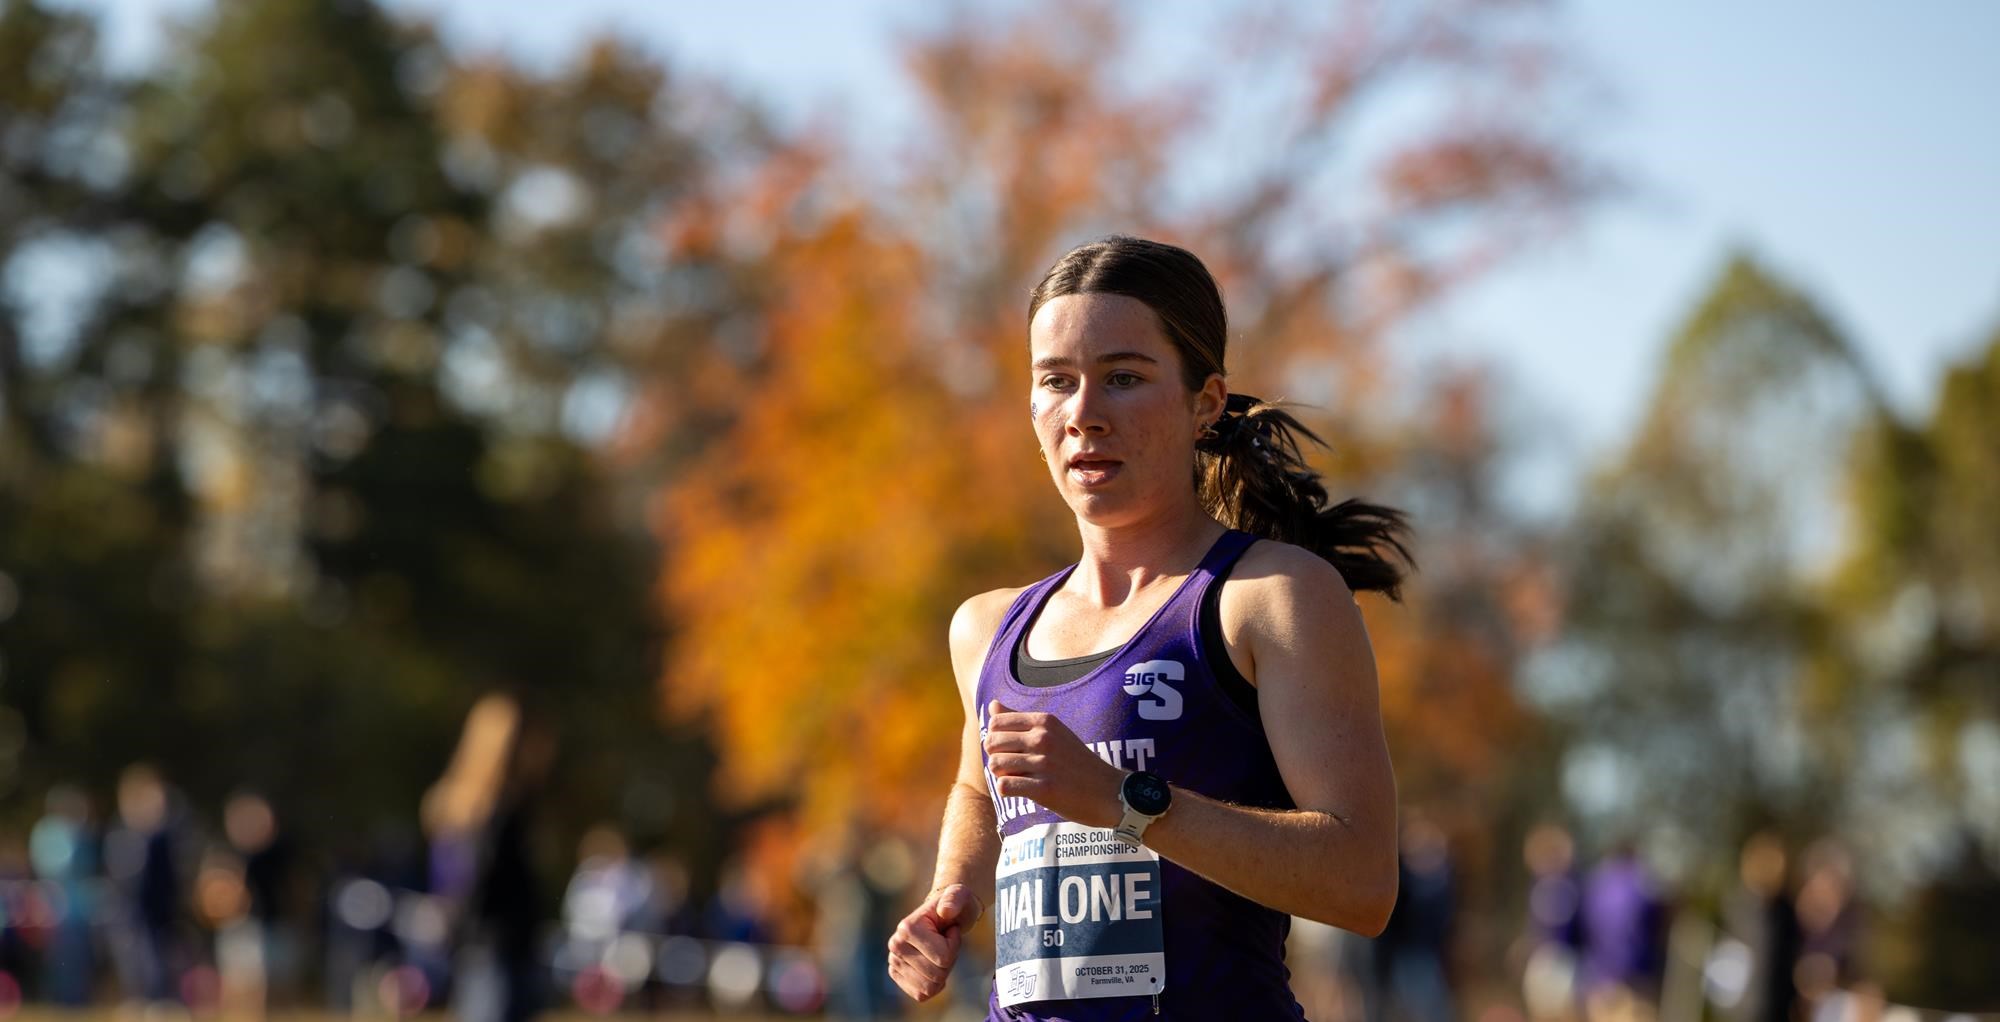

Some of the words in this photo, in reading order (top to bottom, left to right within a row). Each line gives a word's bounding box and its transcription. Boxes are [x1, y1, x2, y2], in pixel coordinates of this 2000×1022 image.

[1124, 672, 1155, 686] BIG
[1138, 659, 1185, 721] S
[1055, 832, 1087, 846] CROSS
[1055, 843, 1138, 859] CHAMPIONSHIPS
[1000, 872, 1153, 936] MALONE
[1043, 929, 1065, 947] 50
[1075, 966, 1113, 977] OCTOBER
[1115, 965, 1128, 975] 31,
[1129, 964, 1150, 974] 2025
[1091, 976, 1124, 985] Farmville,
[1125, 975, 1135, 984] VA
